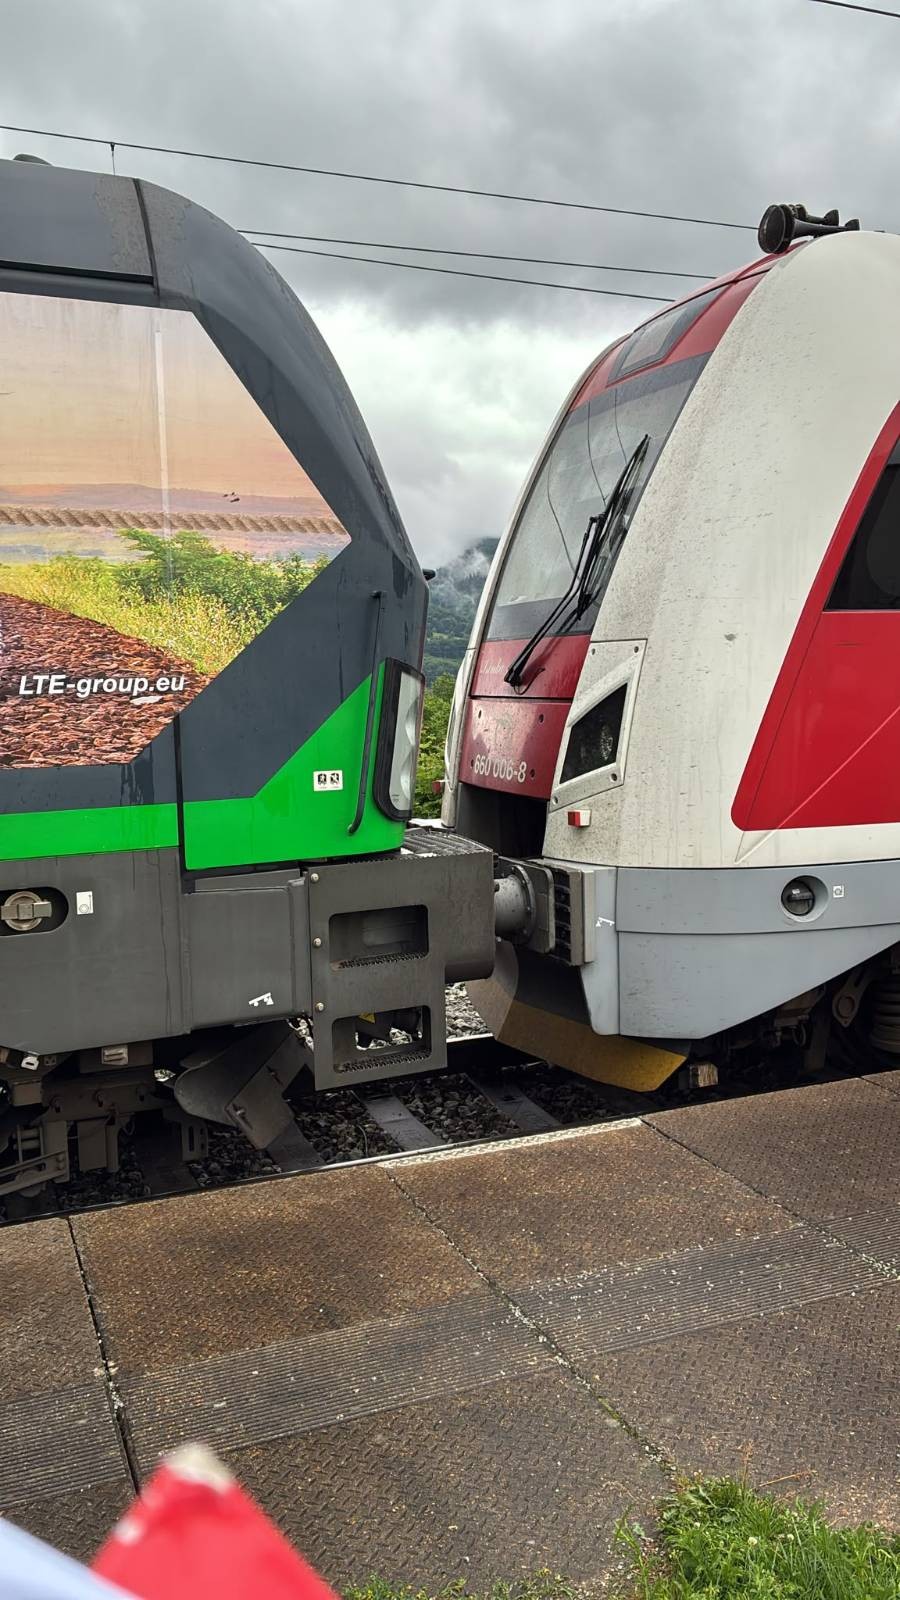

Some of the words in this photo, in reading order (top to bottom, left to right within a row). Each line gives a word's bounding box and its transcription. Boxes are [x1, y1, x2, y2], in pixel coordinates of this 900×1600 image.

[19, 674, 185, 697] LTE-group.eu
[474, 754, 491, 776] 660
[492, 758, 527, 783] 006-8
